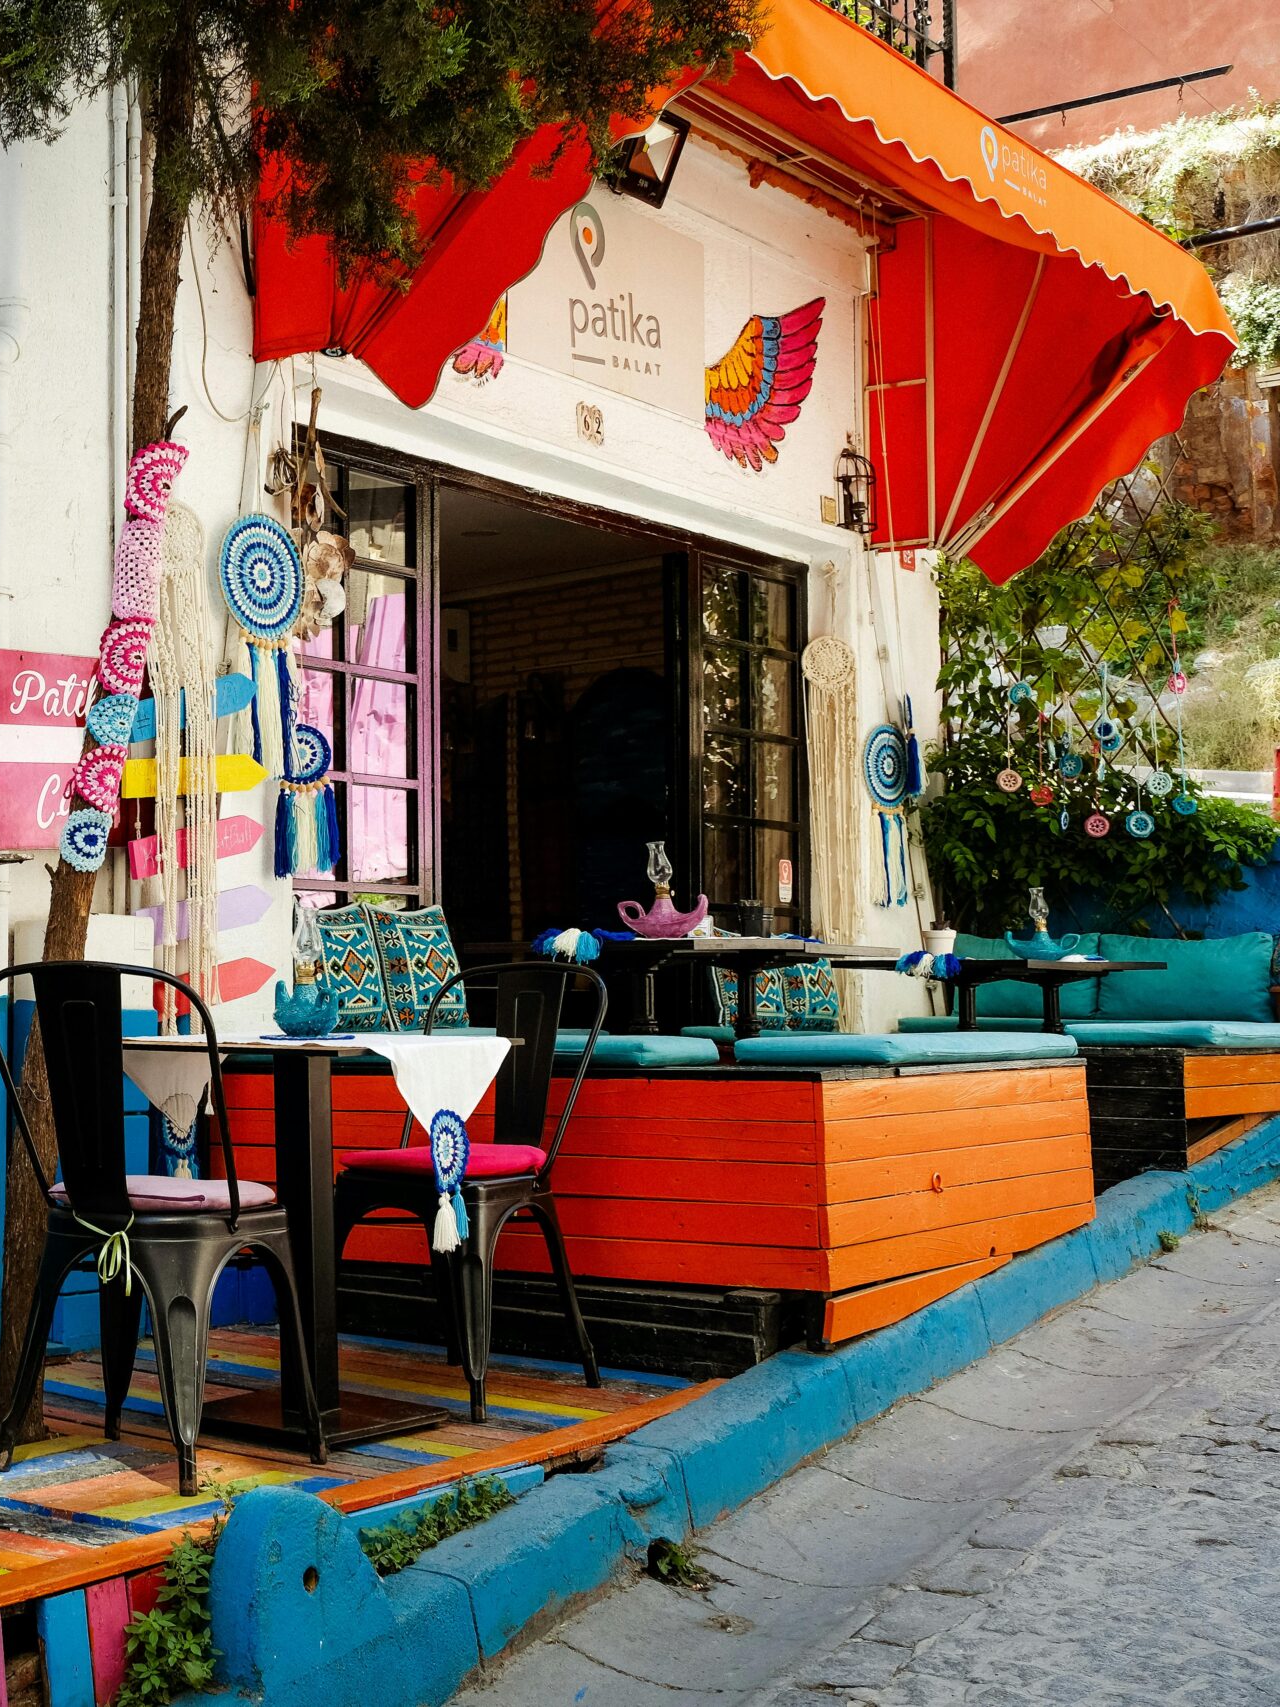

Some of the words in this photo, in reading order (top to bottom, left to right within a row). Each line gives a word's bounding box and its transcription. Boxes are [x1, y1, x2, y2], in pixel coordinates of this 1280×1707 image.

[1001, 144, 1047, 191] patika
[1022, 186, 1047, 208] BALAT
[568, 292, 662, 349] patika
[611, 355, 662, 377] BALAT
[583, 414, 602, 435] 62
